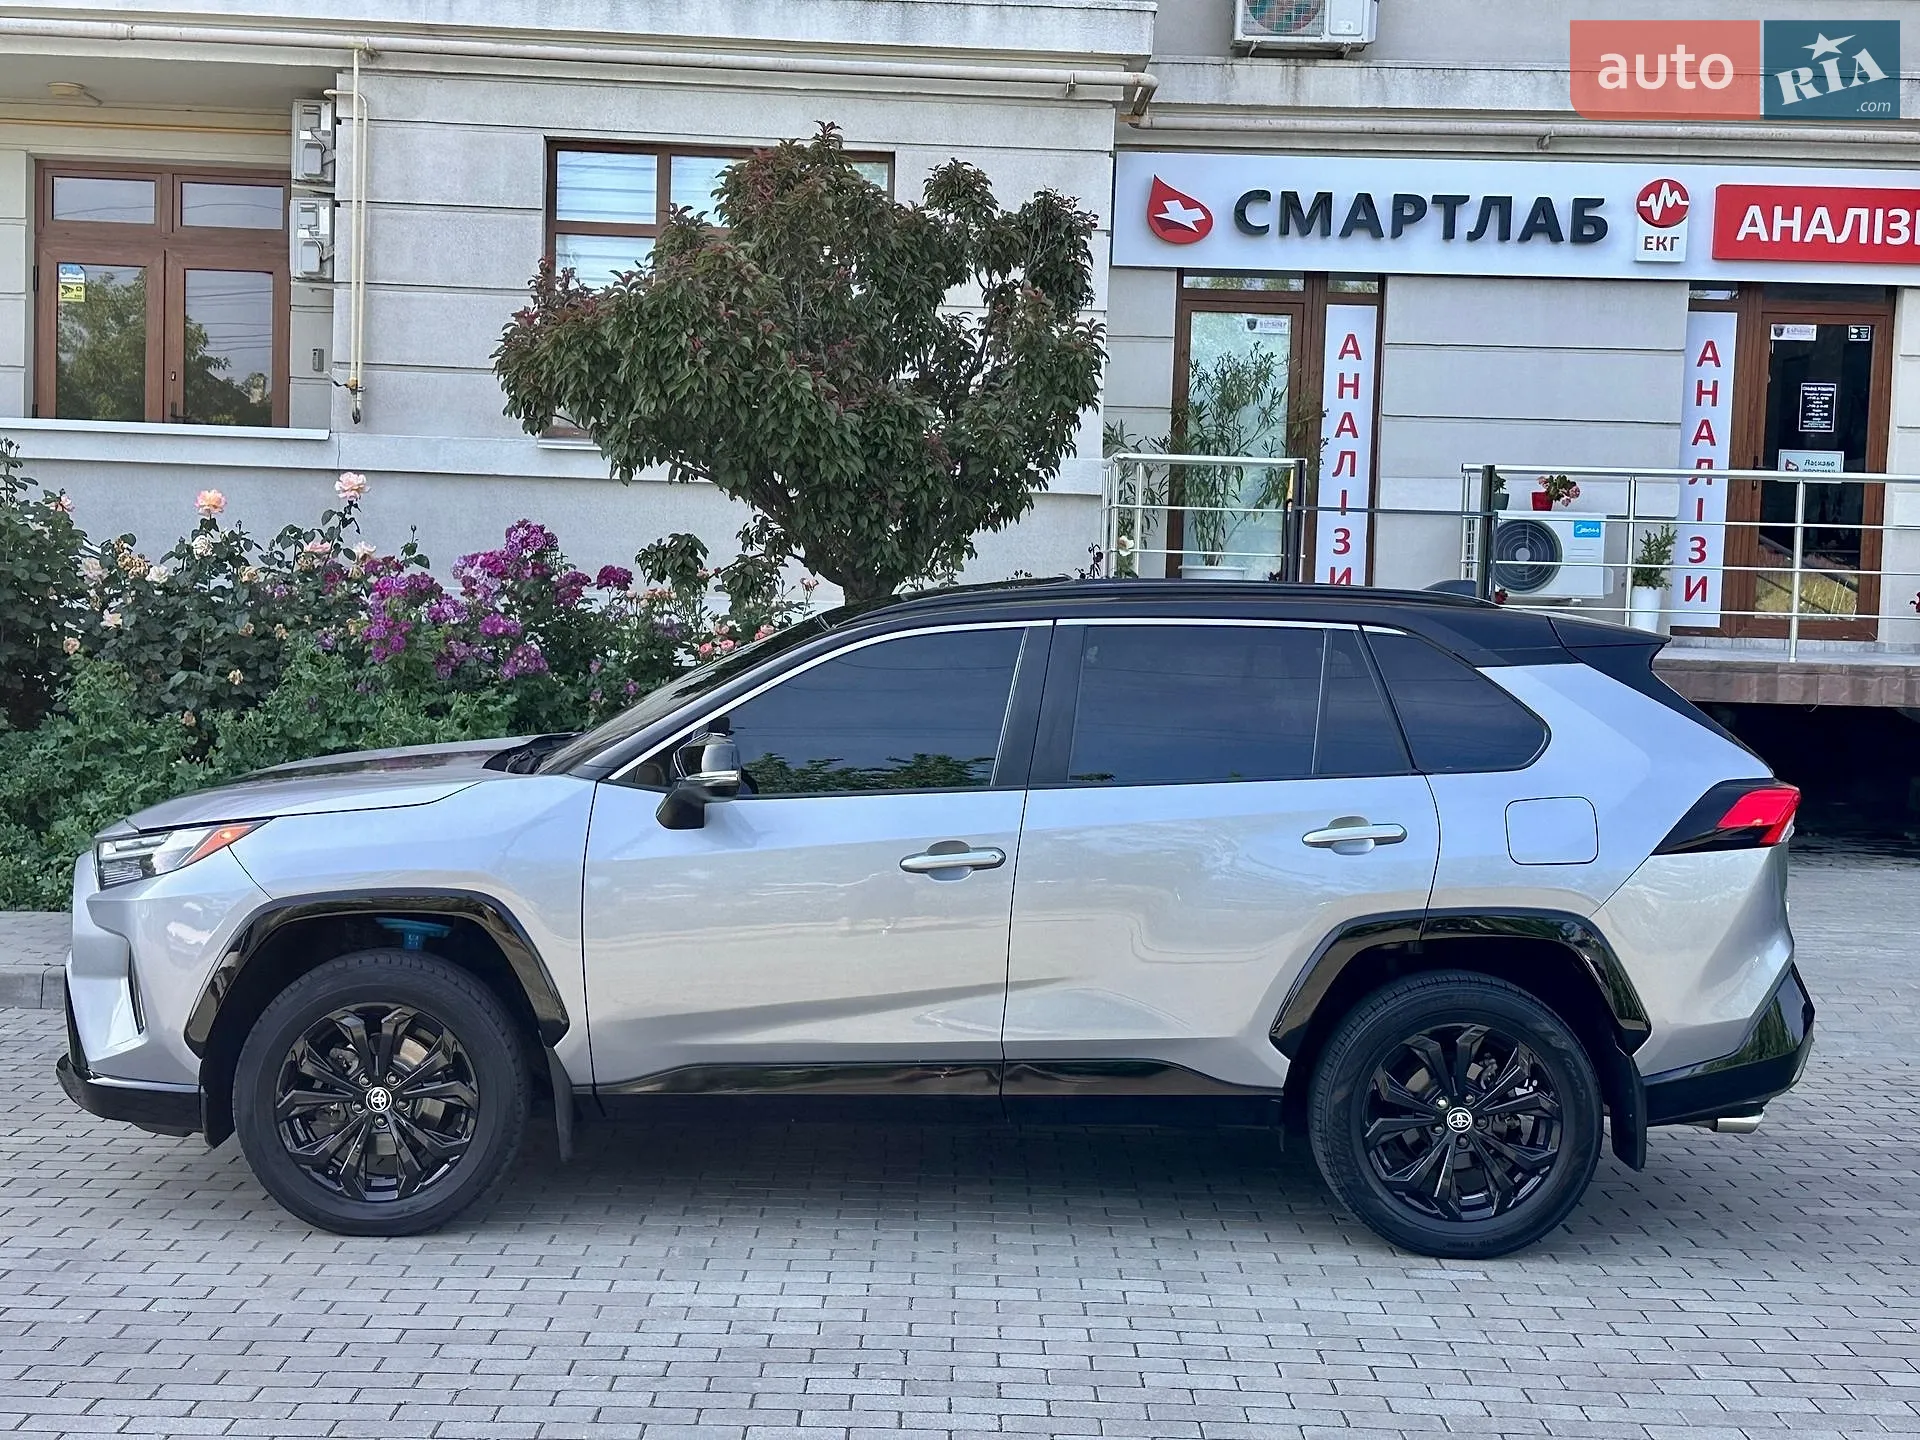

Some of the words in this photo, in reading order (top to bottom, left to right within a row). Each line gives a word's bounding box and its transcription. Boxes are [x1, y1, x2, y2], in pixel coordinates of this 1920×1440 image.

[1233, 189, 1609, 244] СМАРТЛАБ
[1643, 235, 1680, 252] ЕКГ
[1329, 333, 1362, 586] АНАЛІЗИ
[1683, 340, 1722, 603] АНАЛІЗИ
